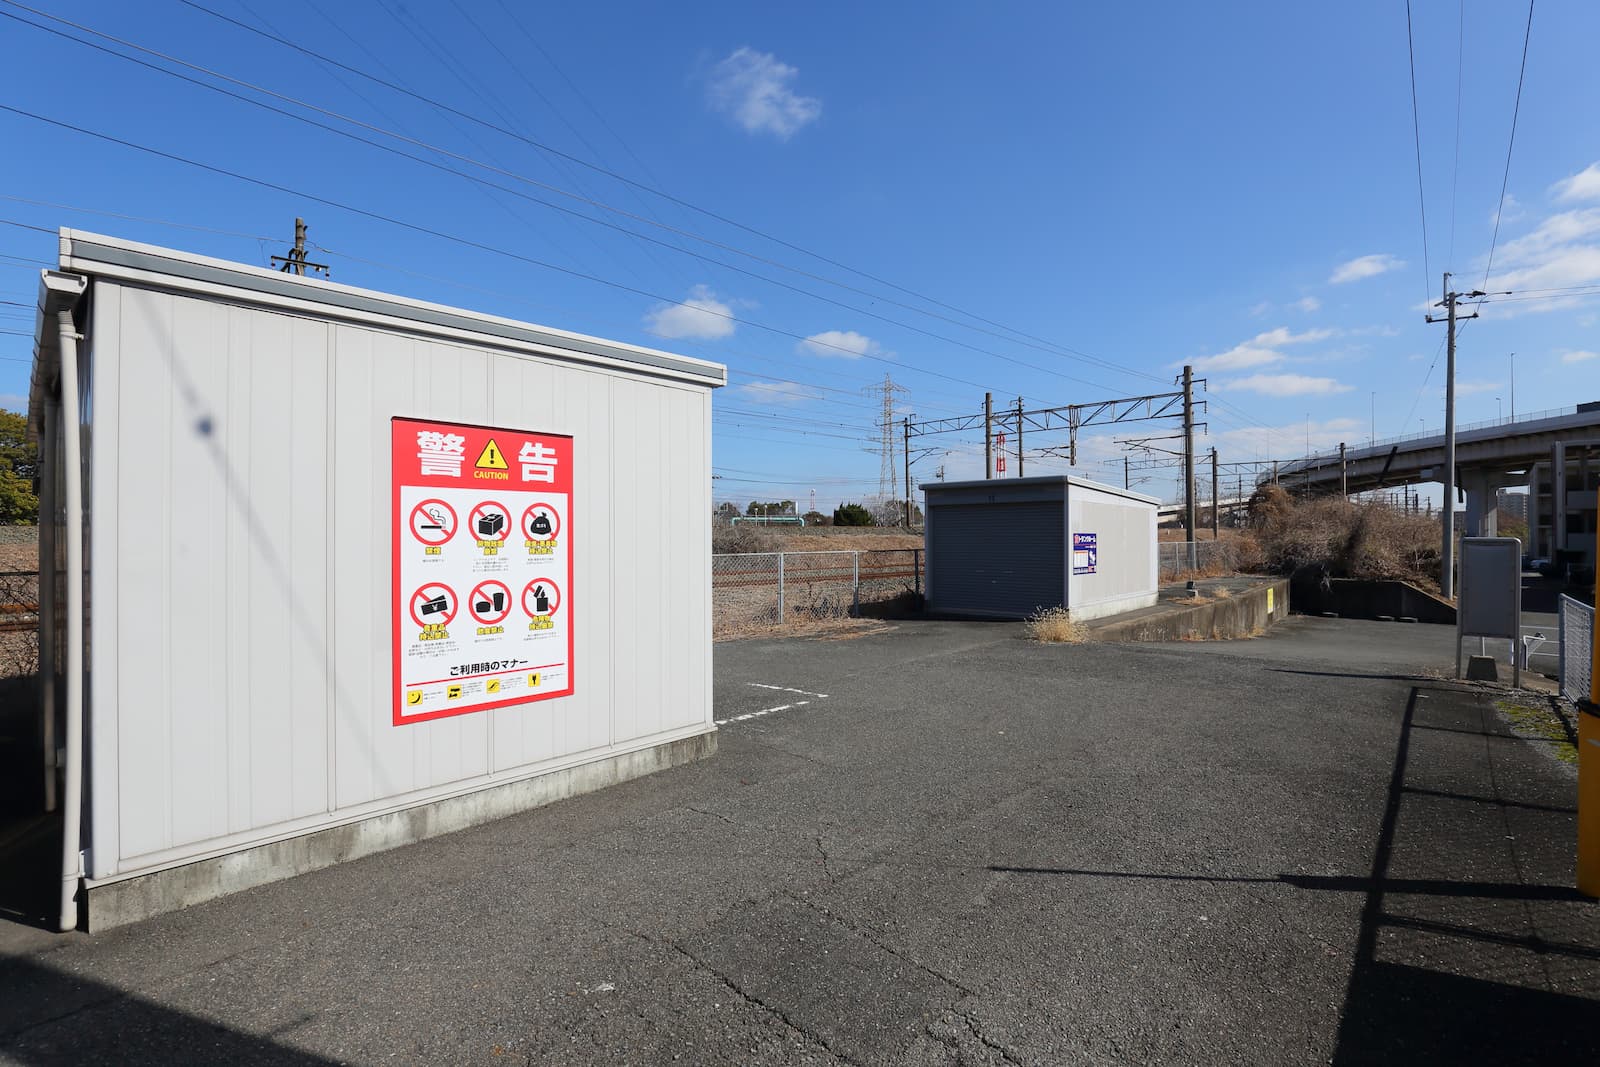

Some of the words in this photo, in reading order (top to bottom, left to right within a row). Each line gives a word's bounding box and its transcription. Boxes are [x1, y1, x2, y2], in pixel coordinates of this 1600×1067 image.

[473, 470, 509, 481] CAUTION
[449, 658, 529, 676] ご利用時のマナー
